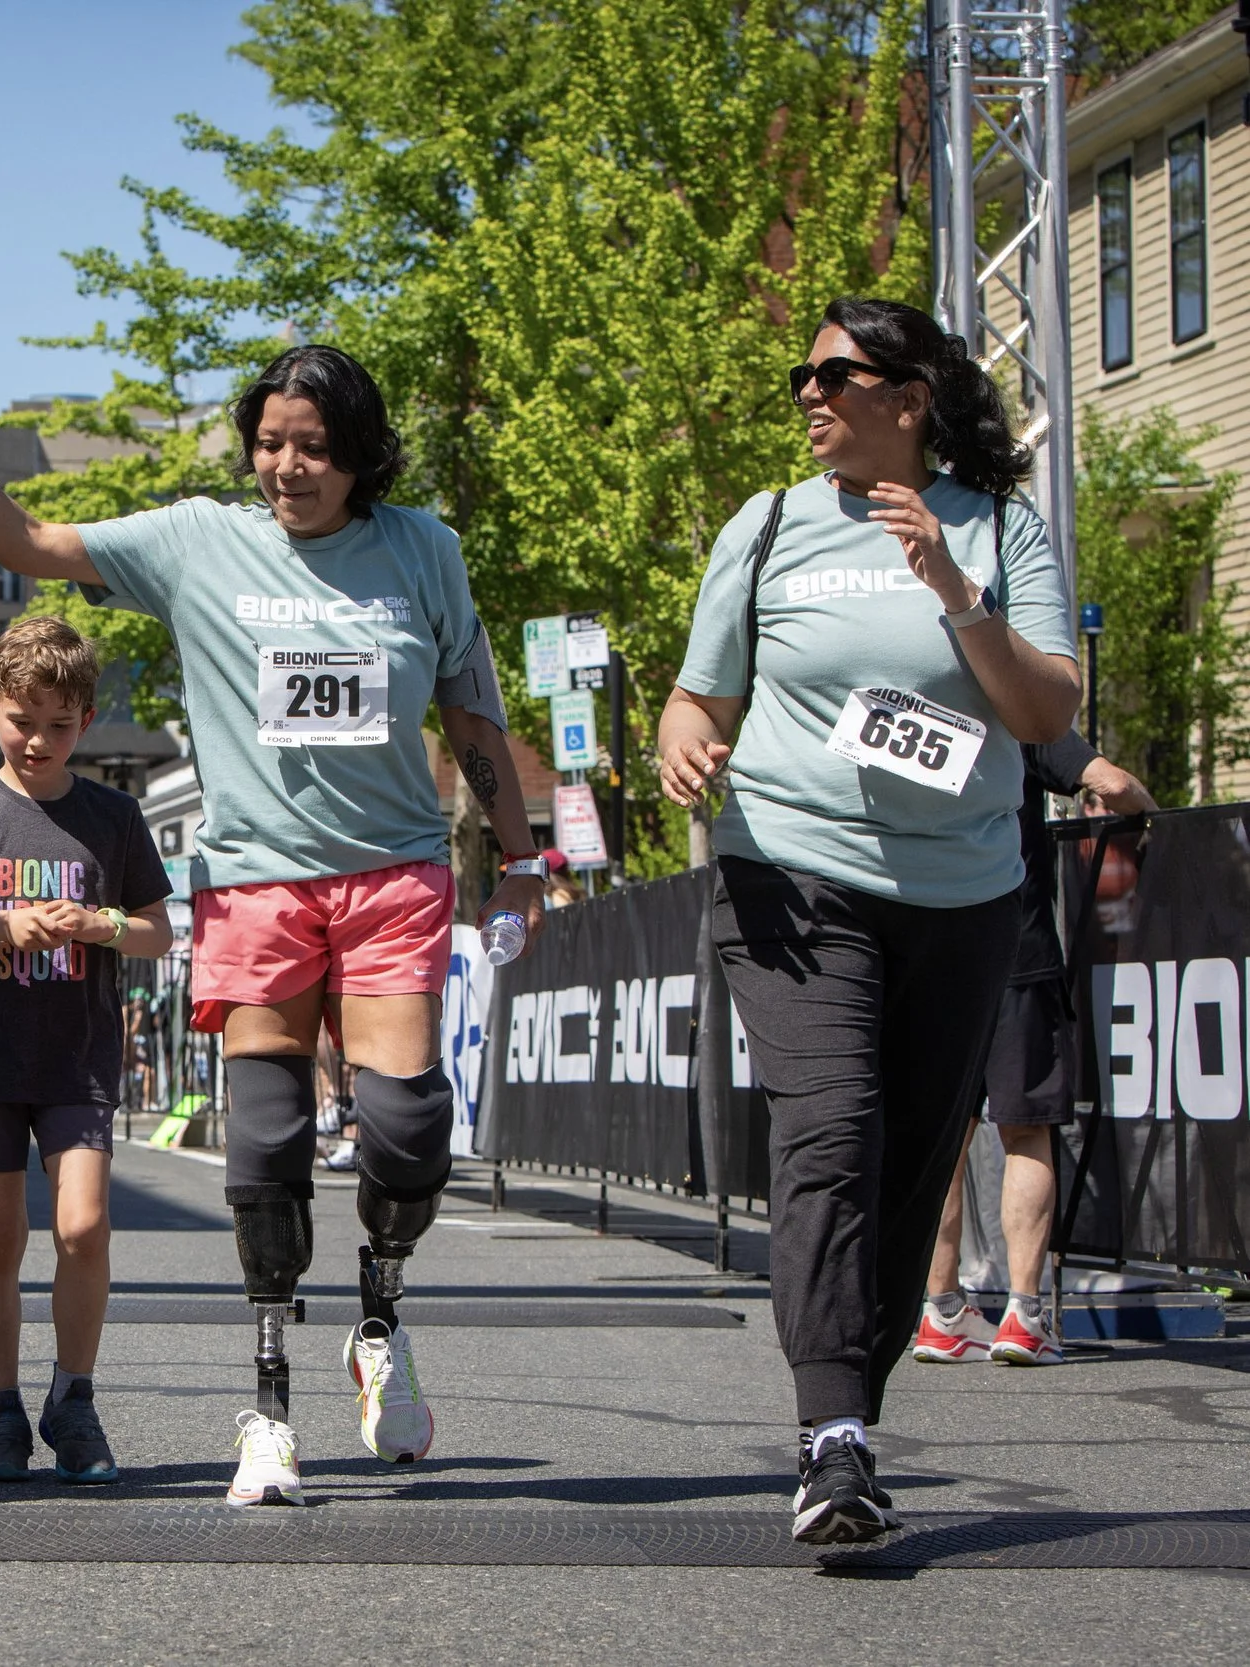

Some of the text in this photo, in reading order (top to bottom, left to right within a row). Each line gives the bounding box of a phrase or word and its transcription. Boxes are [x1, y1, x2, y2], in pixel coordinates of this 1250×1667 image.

[785, 568, 931, 602] BIONIC
[235, 594, 387, 624] BIONIC
[272, 651, 359, 666] BIONIC
[286, 674, 361, 718] 291
[866, 687, 957, 727] BIONIC
[267, 736, 293, 744] FOOD
[834, 747, 861, 762] FOOD
[859, 708, 954, 771] 635
[1091, 957, 1250, 1121] BIO
